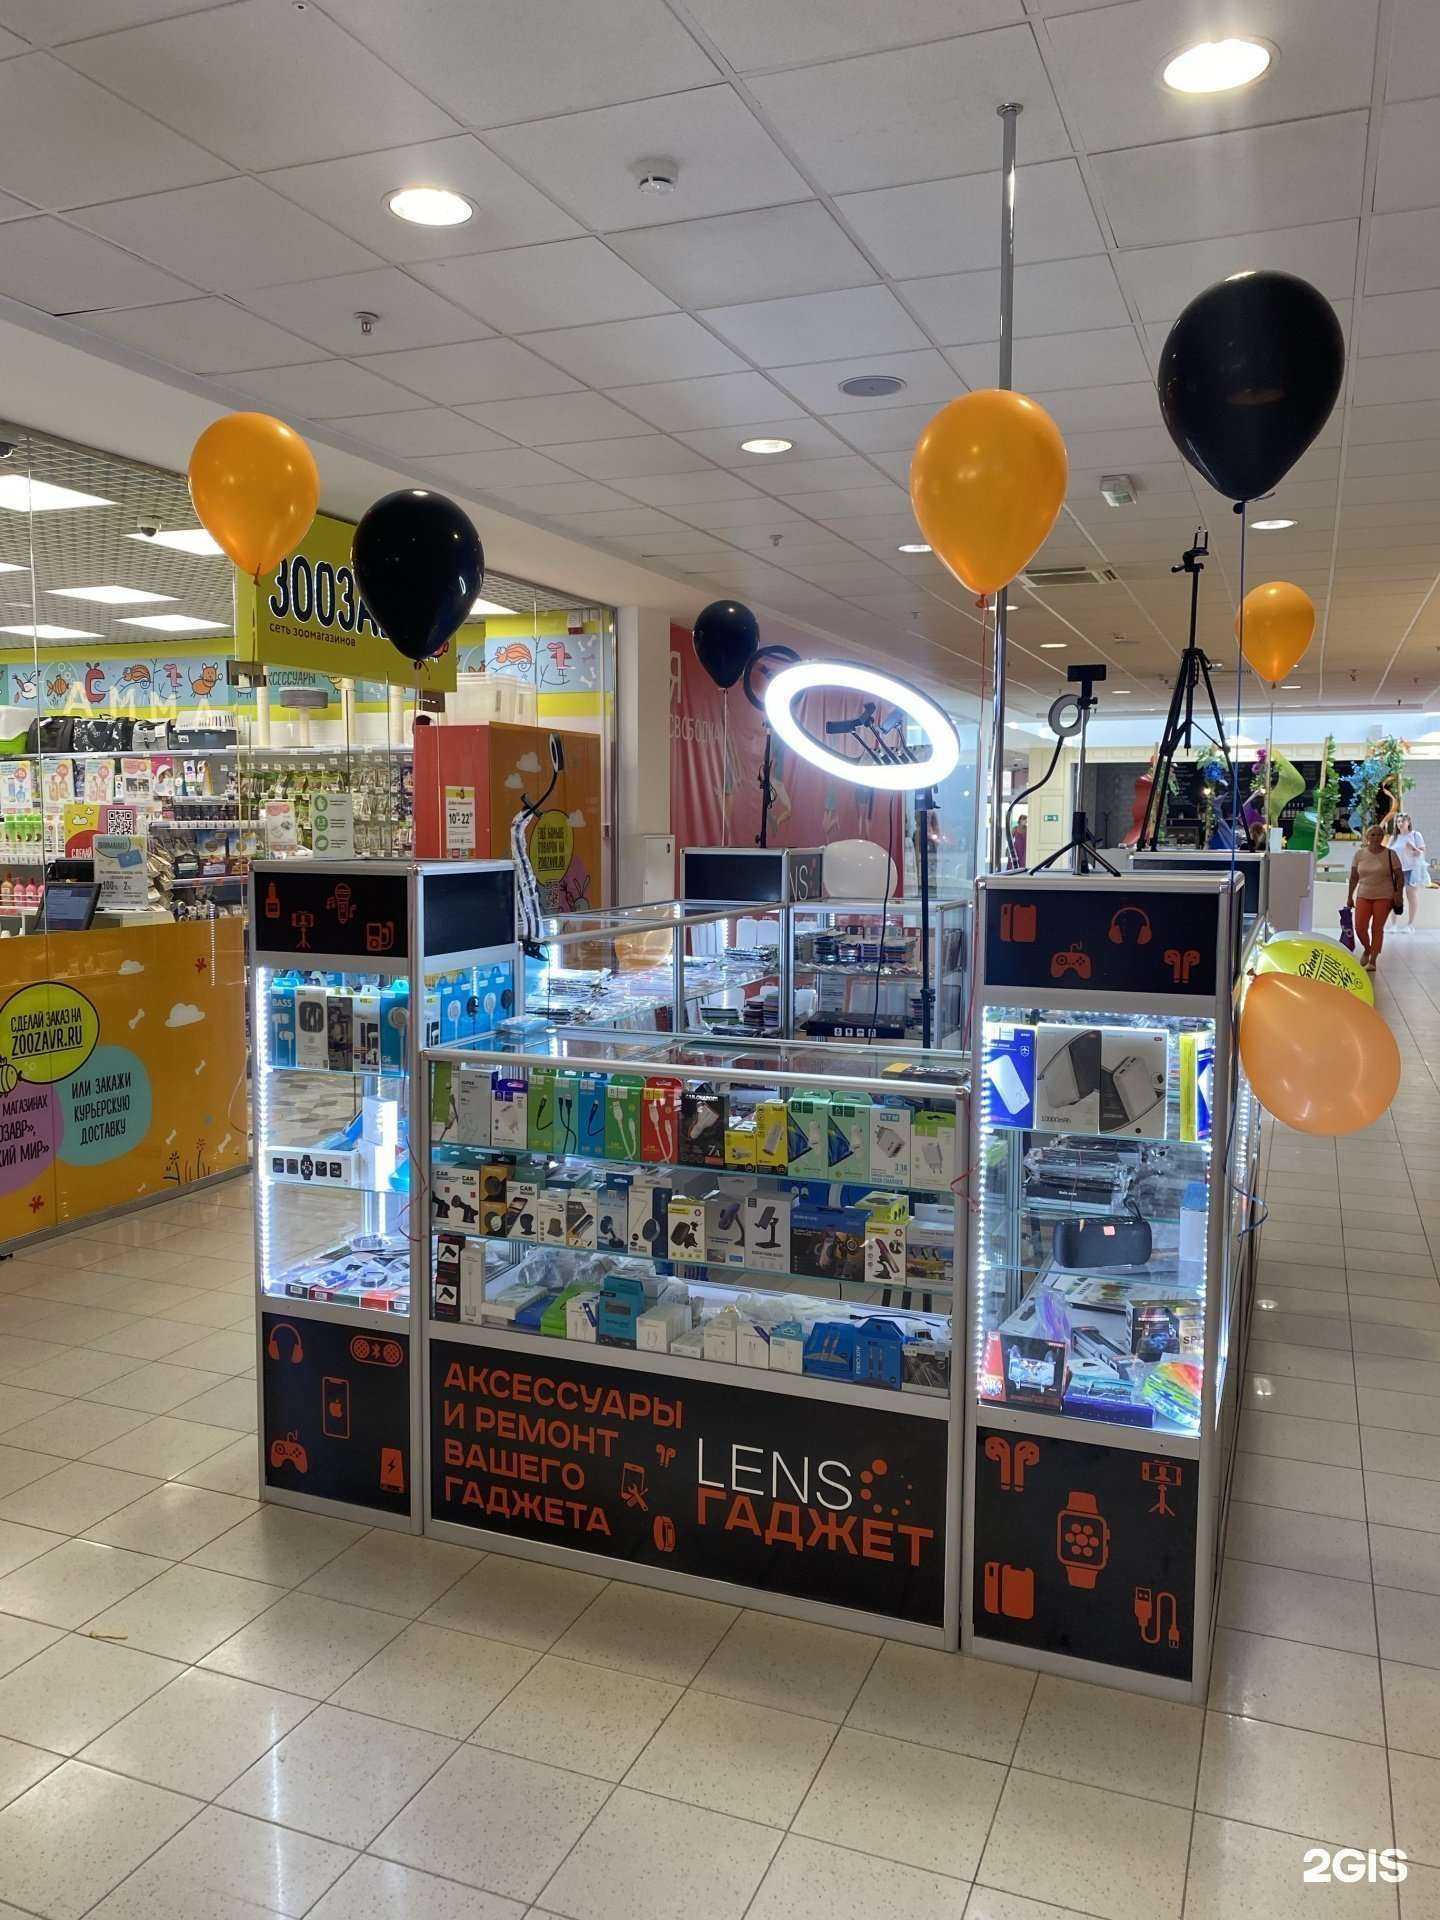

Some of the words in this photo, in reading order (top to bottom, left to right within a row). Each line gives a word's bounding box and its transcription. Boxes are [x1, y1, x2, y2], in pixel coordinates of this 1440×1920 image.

[268, 555, 391, 640] ЗООЗА
[292, 627, 356, 647] зоомагазинов
[267, 671, 316, 686] КСЕССУАРЫ
[11, 1011, 44, 1033] СДЕЛАЙ
[46, 1008, 70, 1027] ЗАКАЗ
[71, 1007, 82, 1022] НА
[12, 1025, 82, 1056] ZOOZAVR.RU
[72, 1082, 91, 1100] ИЛИ
[95, 1072, 131, 1096] ЗАКАЖИ
[3, 1094, 48, 1117] МАГАЗИНАХ
[74, 1095, 130, 1123] КУРЬЕРСКУЮ
[80, 1118, 126, 1146] ДОСТАВКУ
[20, 1140, 49, 1162] МИР»
[443, 1362, 683, 1429] АКСЕССУАРЫ
[444, 1400, 465, 1429] И
[475, 1406, 619, 1457] РЕМОНТ
[444, 1438, 585, 1491] ВАШЕГО
[698, 1438, 852, 1511] LENS
[445, 1476, 613, 1536] ГАДЖЕТА
[698, 1486, 934, 1567] ГАДЖЕТ
